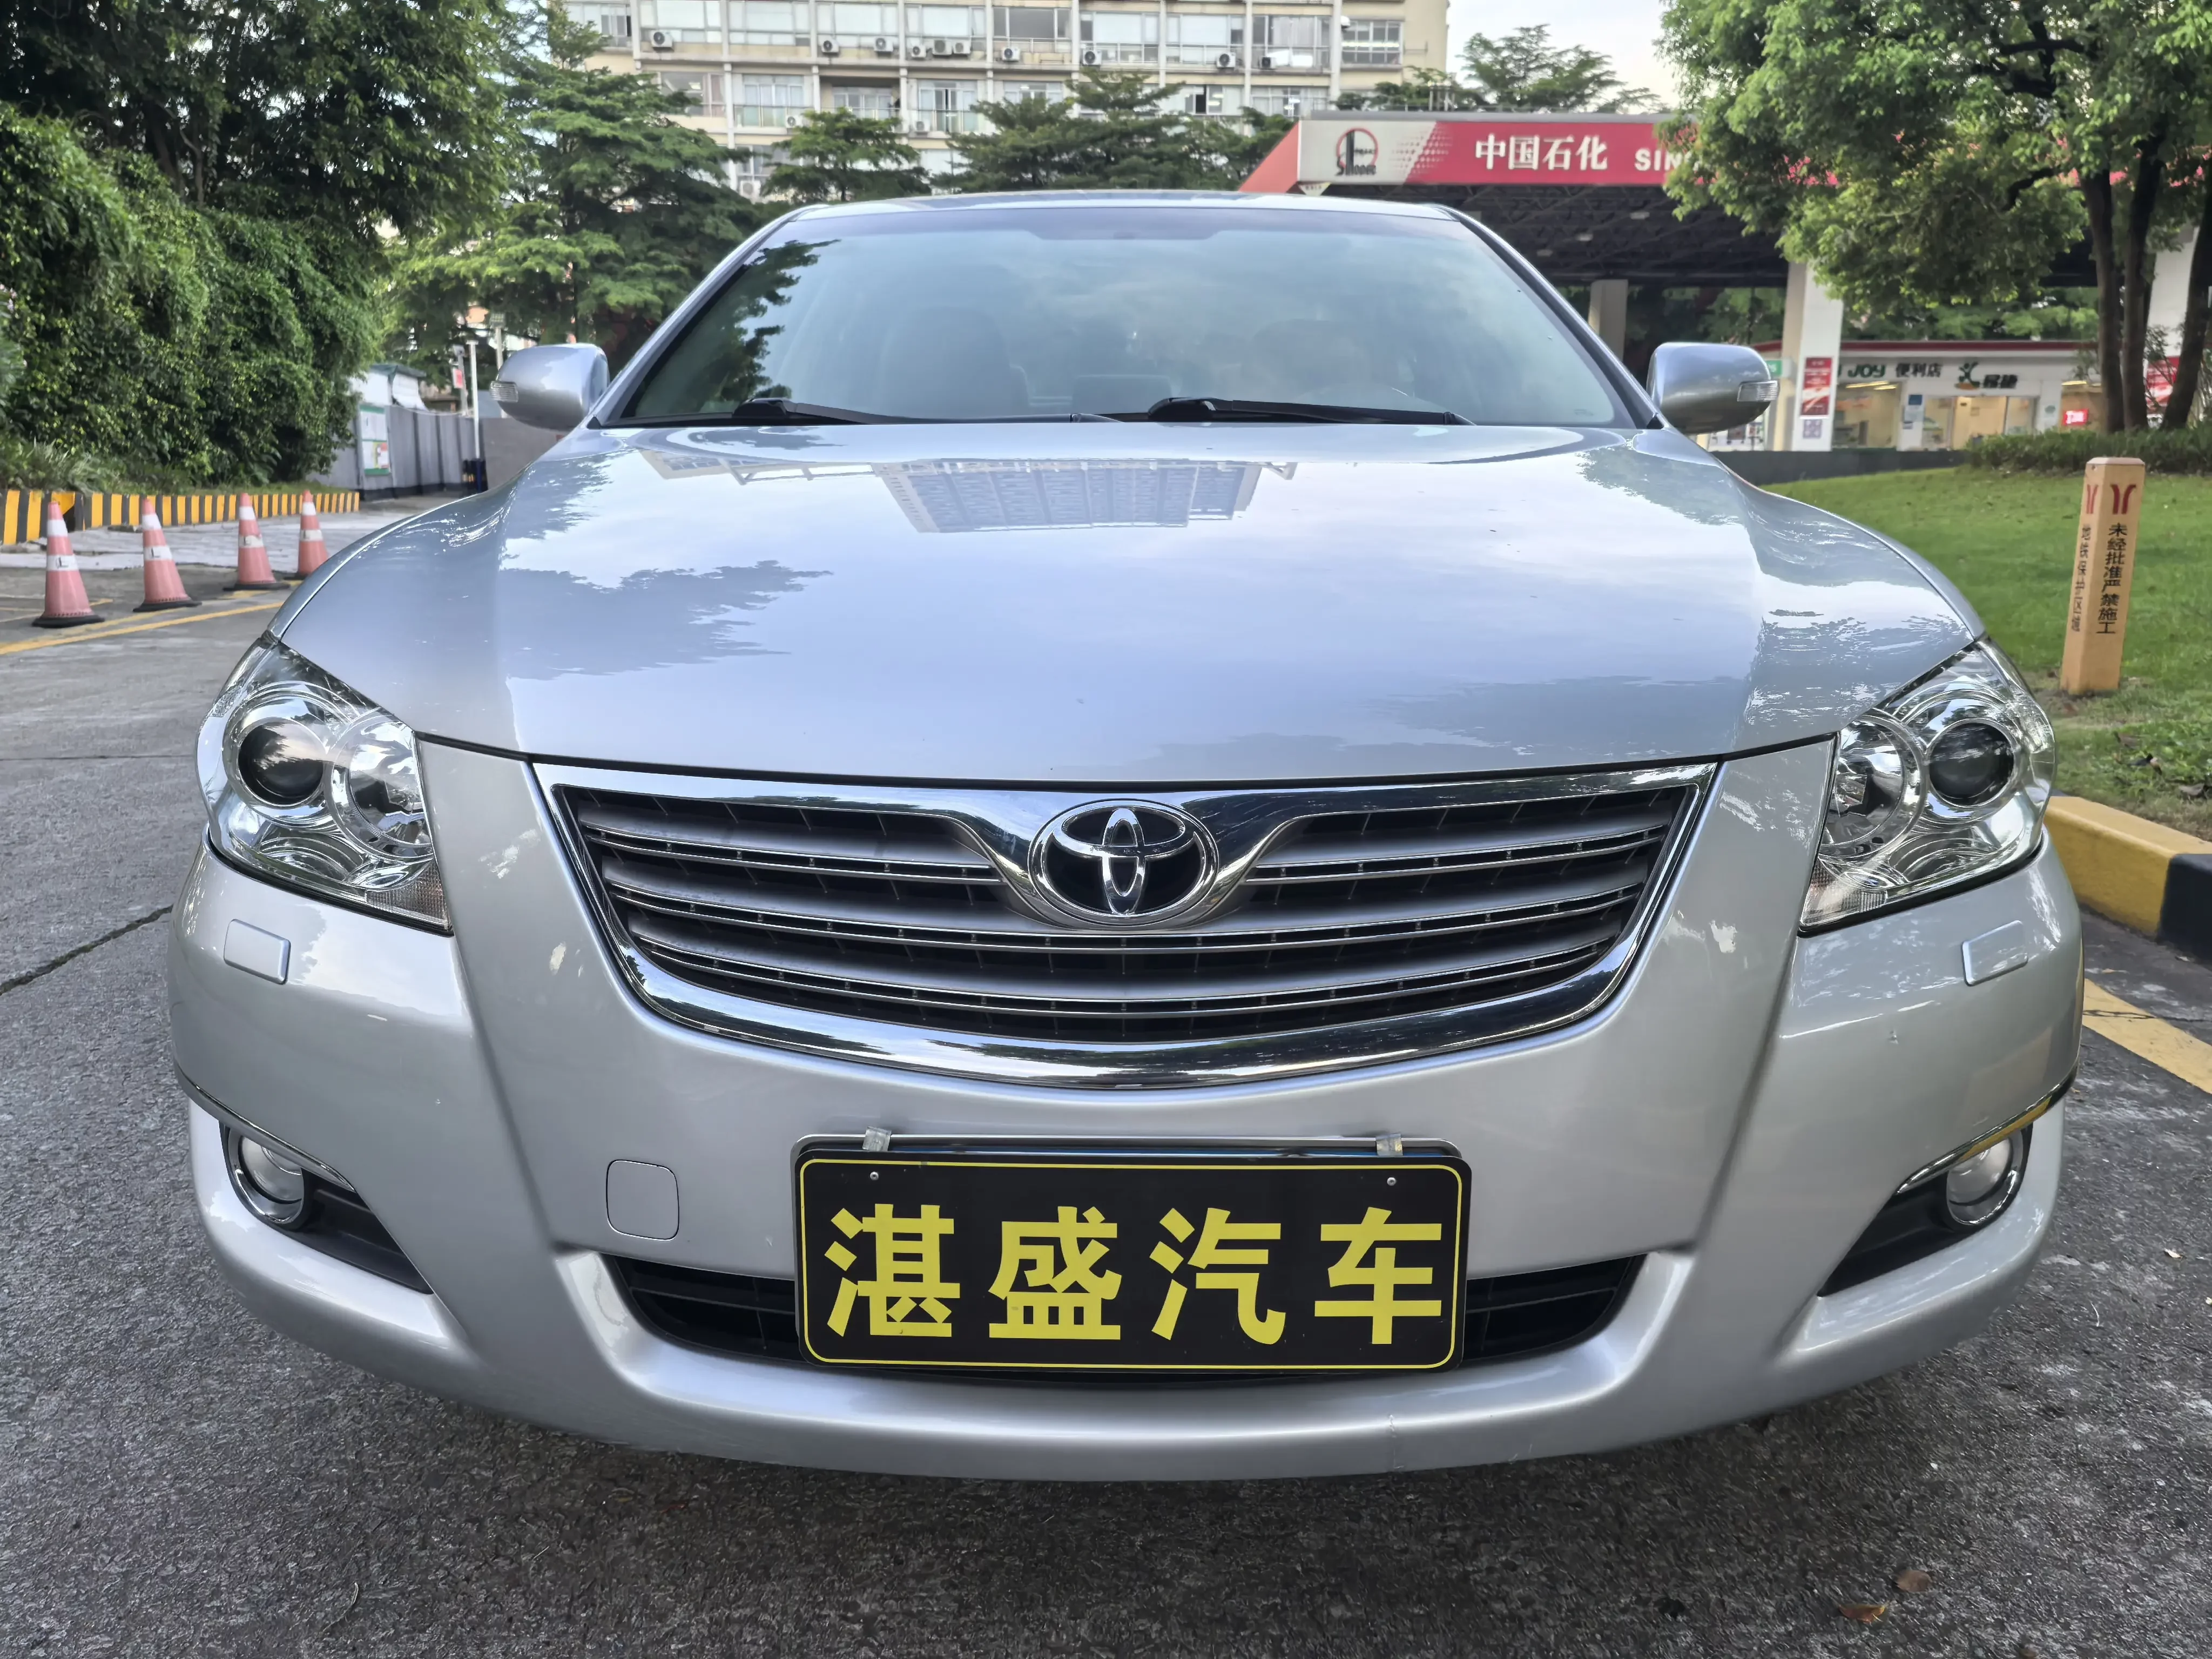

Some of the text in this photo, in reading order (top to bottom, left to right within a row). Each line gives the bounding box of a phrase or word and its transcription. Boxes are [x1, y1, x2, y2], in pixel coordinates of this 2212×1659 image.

[1475, 133, 1608, 171] 中国石化
[1847, 363, 1886, 378] JOY
[1896, 363, 1943, 377] 便利店
[2096, 522, 2128, 633] 未经批准严禁施工
[824, 1203, 1442, 1345] 湛盛汽车
